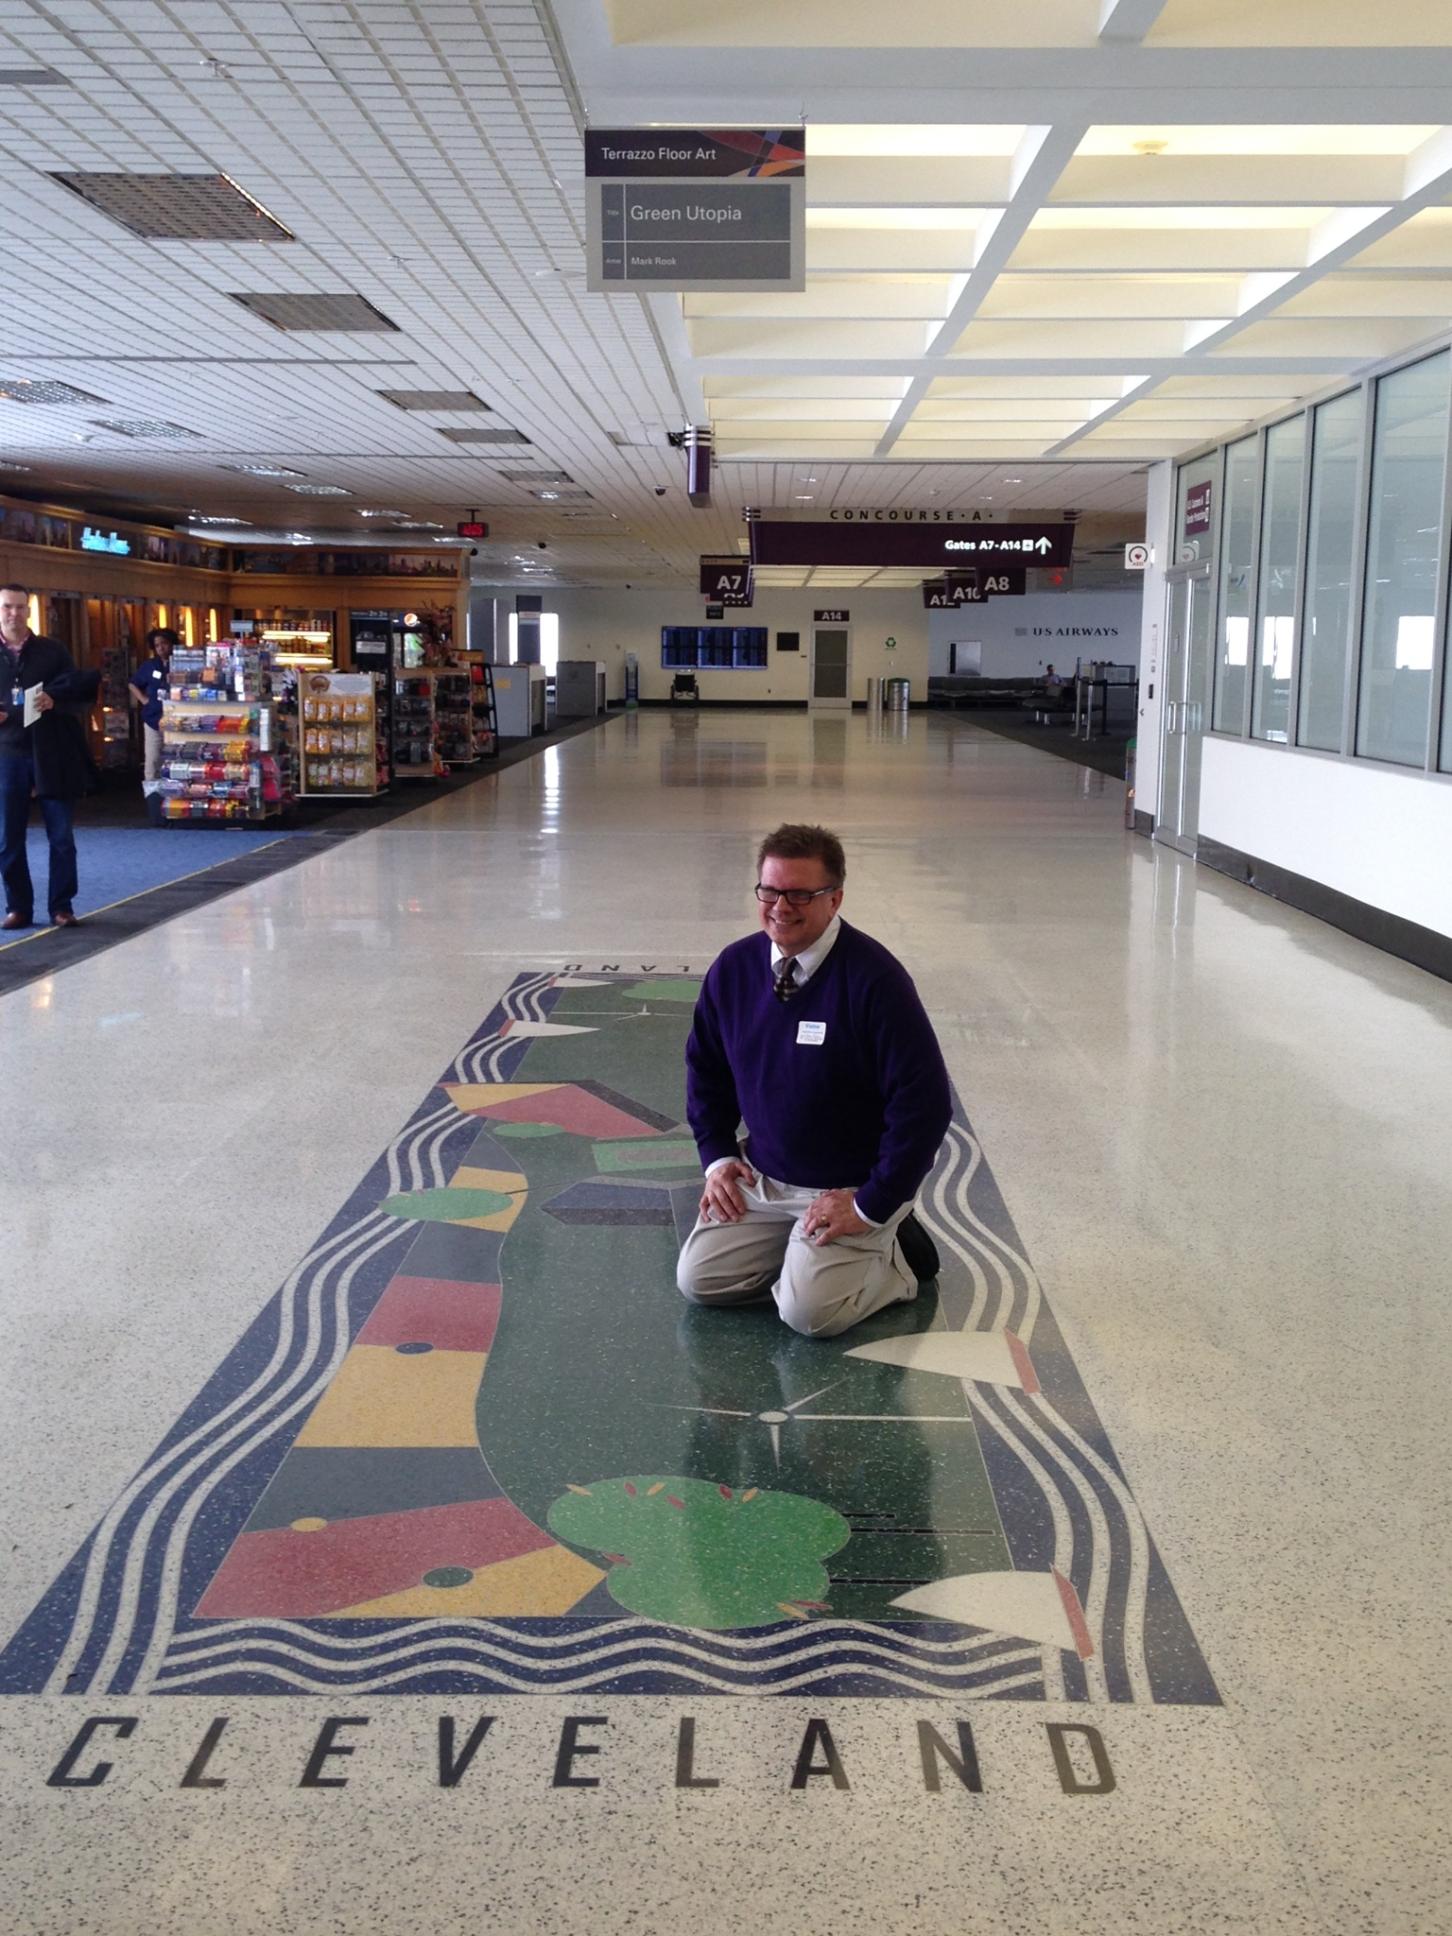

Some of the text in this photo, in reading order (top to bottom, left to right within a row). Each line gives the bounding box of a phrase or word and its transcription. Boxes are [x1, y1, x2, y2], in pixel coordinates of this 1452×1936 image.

[601, 147, 716, 160] Terrazzo Floor Art
[630, 205, 742, 224] Green Utopia
[631, 256, 676, 265] Mark Rook
[830, 510, 954, 521] CONCOURSE
[944, 540, 1021, 550] Gates A7-A14
[716, 575, 742, 590] A7
[984, 576, 1010, 591] A8
[930, 594, 955, 605] A1
[821, 611, 842, 620] A14
[1033, 628, 1119, 636] US AIRWAYS
[45, 1716, 1117, 1795] CLEVELAND
